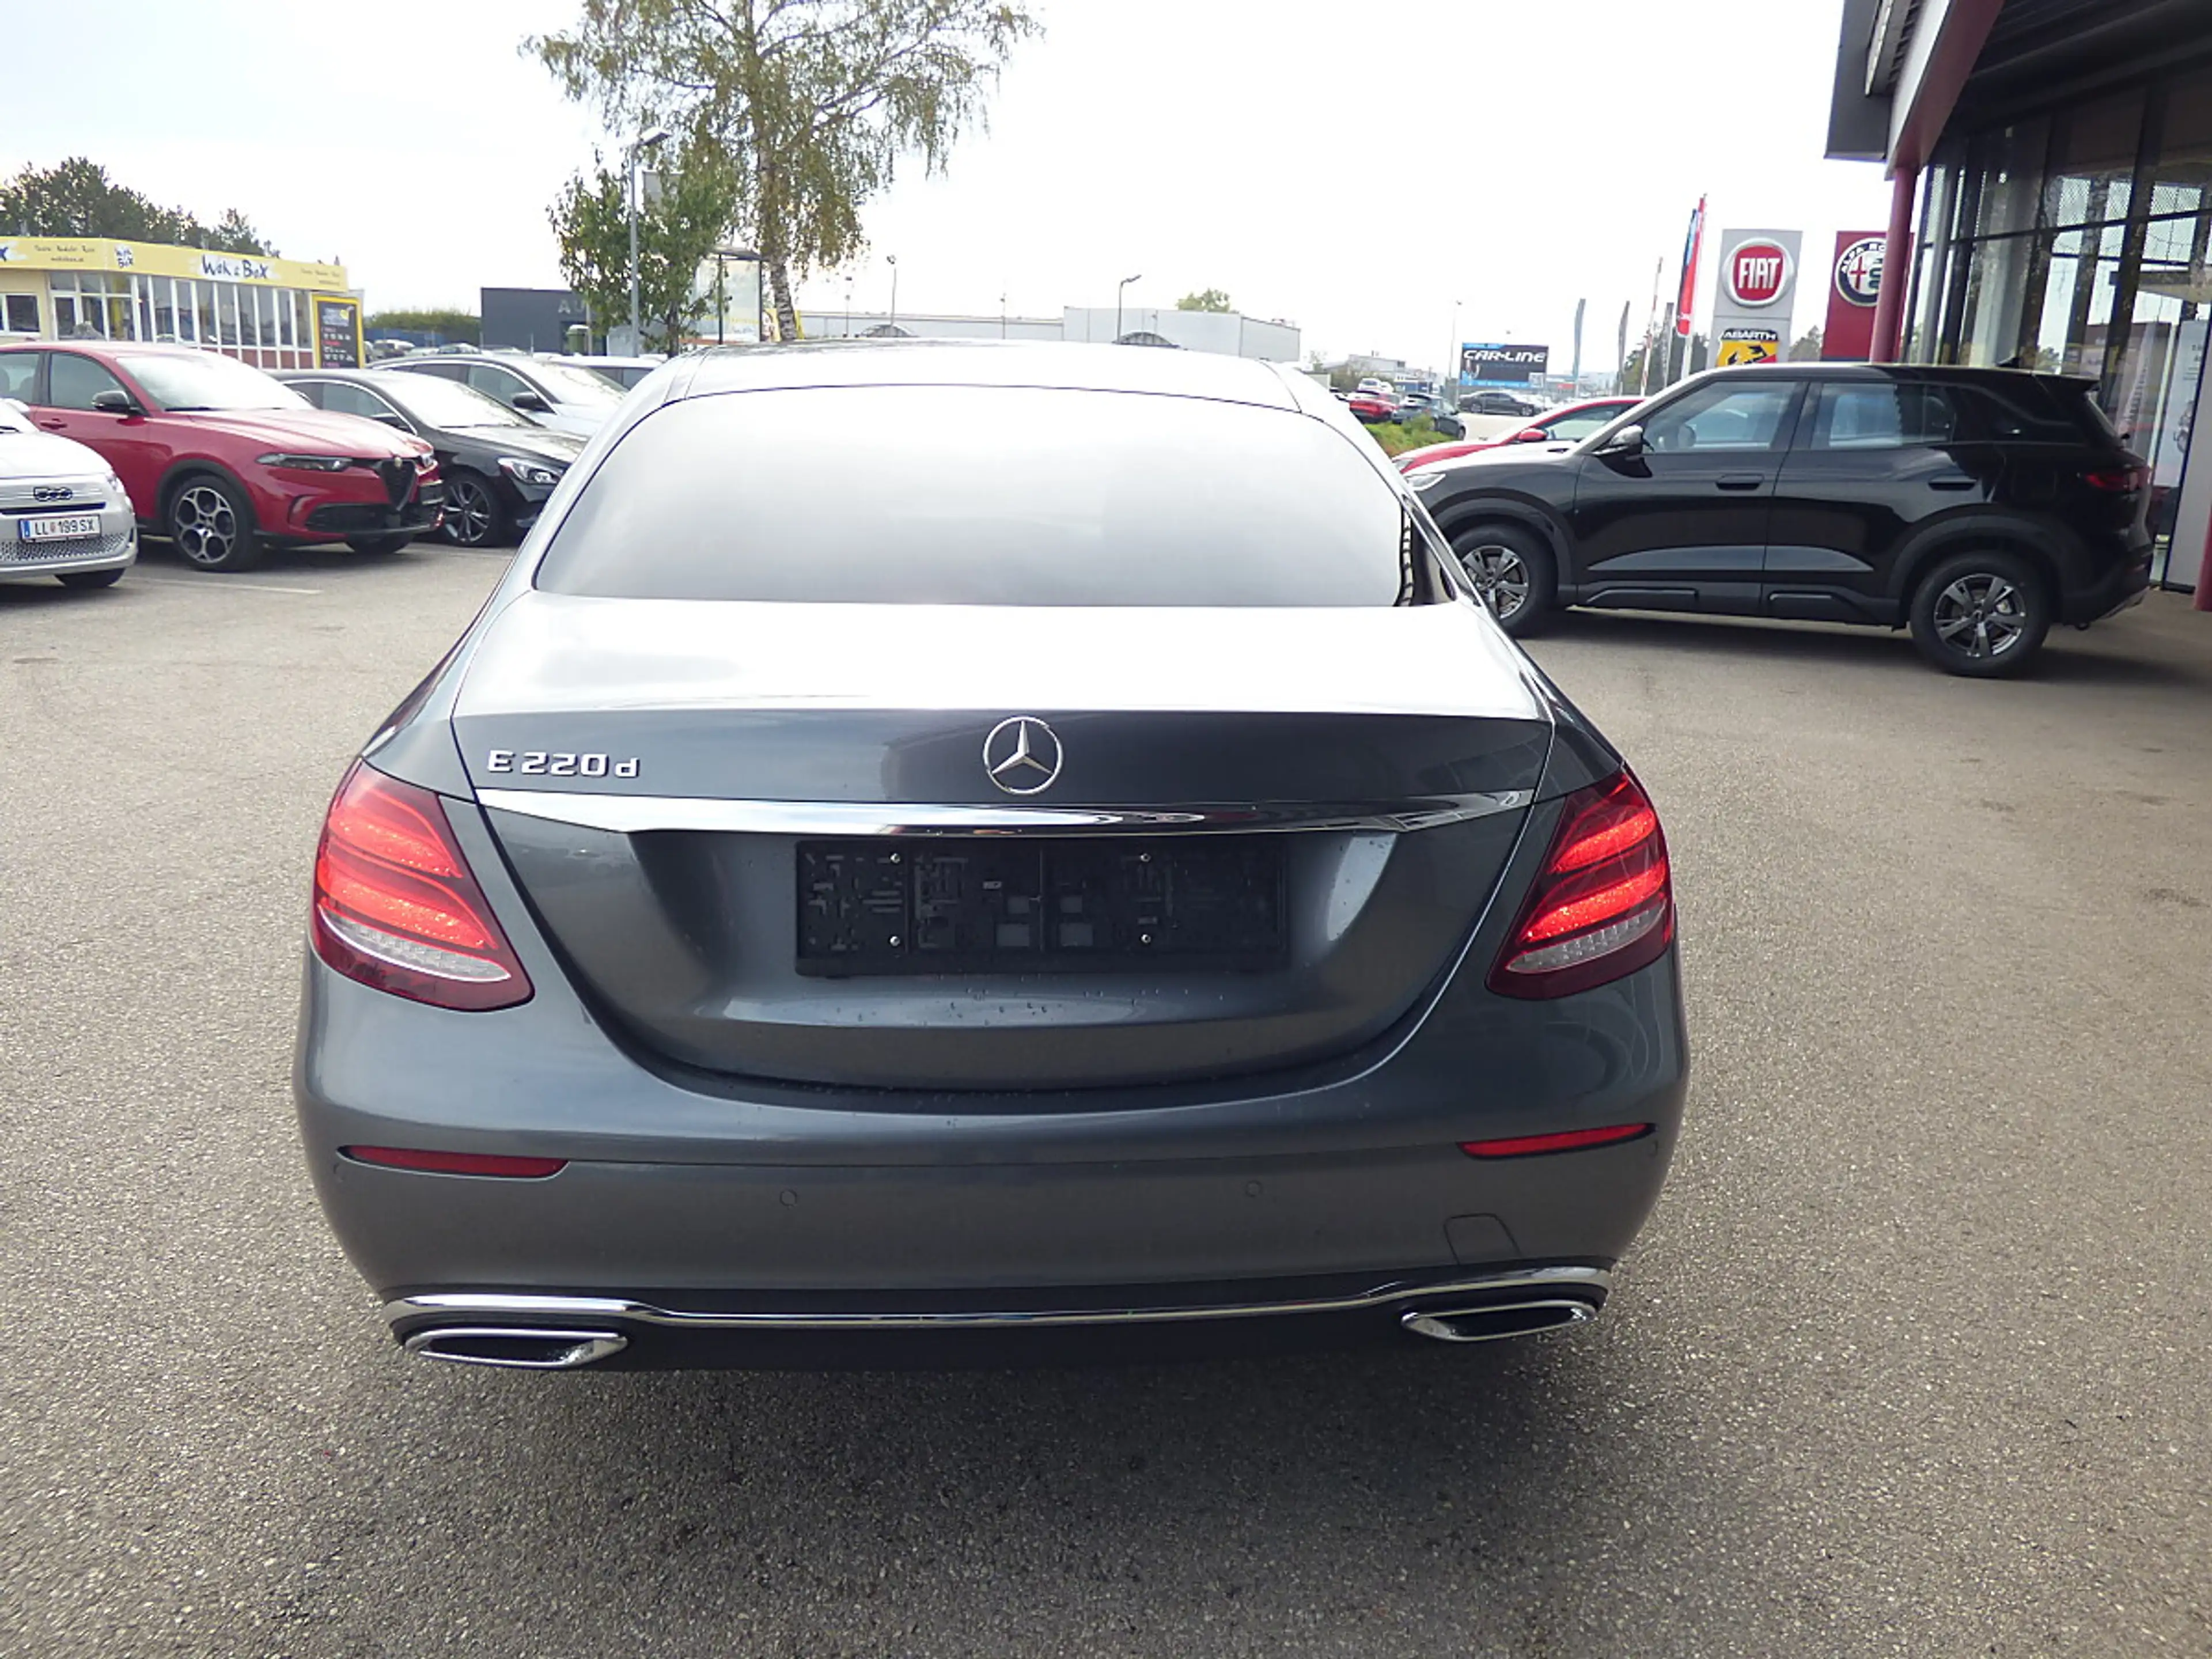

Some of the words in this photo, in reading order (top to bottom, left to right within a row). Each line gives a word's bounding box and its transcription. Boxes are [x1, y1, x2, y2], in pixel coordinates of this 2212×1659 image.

[1737, 257, 1781, 289] FIAT
[1723, 330, 1777, 340] ABARTH
[34, 522, 48, 535] LL
[488, 749, 516, 772] E
